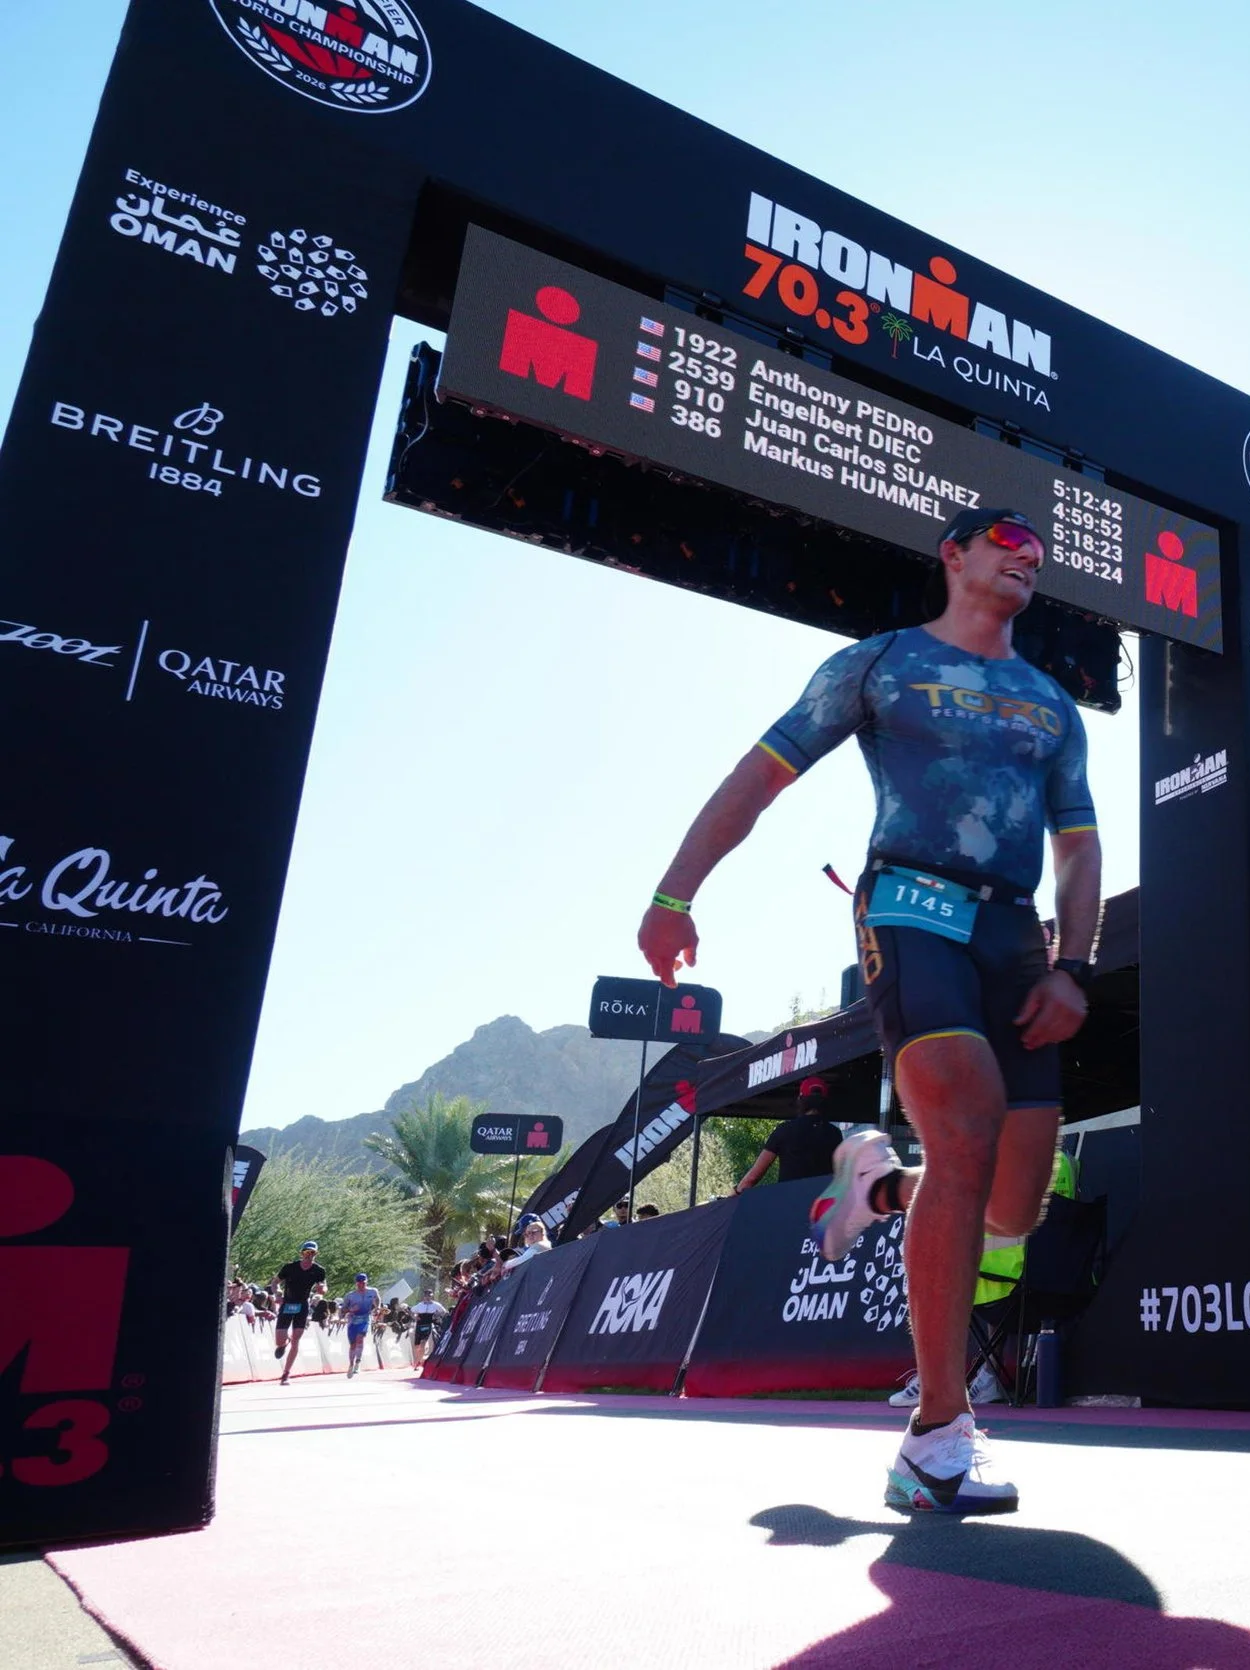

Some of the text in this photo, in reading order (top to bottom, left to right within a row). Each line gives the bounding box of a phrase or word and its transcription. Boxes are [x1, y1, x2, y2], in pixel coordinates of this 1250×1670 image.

[233, 0, 414, 86] ORLD CHAMPIONSHIP
[295, 71, 327, 91] 2026
[125, 168, 247, 226] Experience
[110, 213, 237, 274] OMAN
[742, 243, 870, 345] 70.3
[746, 190, 1052, 377] IRONMAN
[913, 336, 1052, 412] LA QUINTA
[51, 401, 322, 498] BREITLING
[668, 351, 1123, 542] 2539 Engelbert DIEC 4:59:52
[674, 327, 1123, 521] 1922 Anthony PEDRO 5:12:42
[149, 462, 222, 497] 1884
[670, 404, 1123, 584] 386 Markus HUMMEL 5:09:24
[674, 379, 1123, 562] 910 Juan Carlos SUAREZ 5:18:23
[158, 649, 286, 694] QATAR
[187, 680, 284, 711] AIRWAYS
[908, 683, 1063, 737] TORO
[41, 847, 229, 924] Quinta
[895, 885, 955, 917] 1145
[25, 920, 133, 943] CALIFORNIA
[747, 1032, 818, 1089] IRONMAN
[477, 1126, 513, 1137] QATAR
[485, 1133, 513, 1142] AIRWAYS
[588, 1268, 675, 1334] HOKA
[782, 1291, 850, 1322] OMAN
